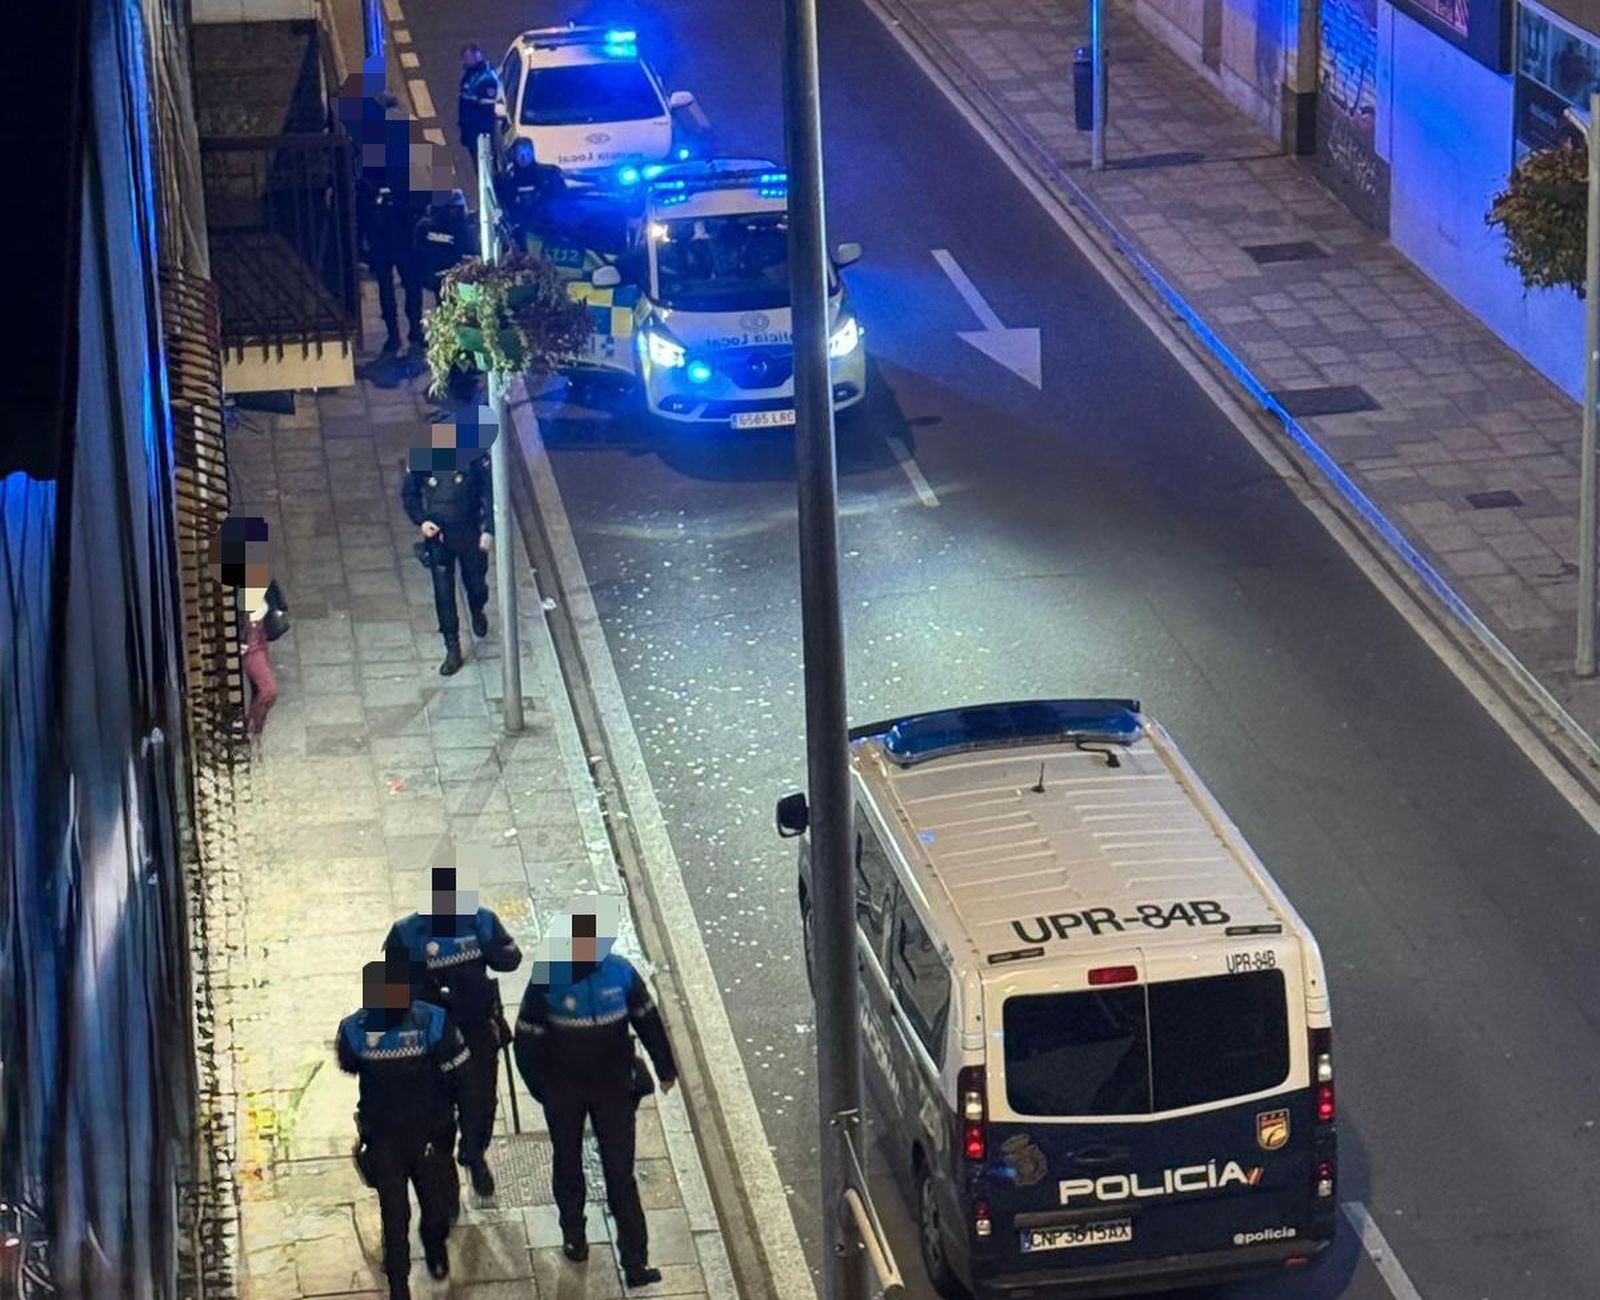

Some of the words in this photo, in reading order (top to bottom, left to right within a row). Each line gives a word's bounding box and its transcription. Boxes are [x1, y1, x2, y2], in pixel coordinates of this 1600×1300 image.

[1011, 900, 1231, 944] UPR-84B
[1225, 950, 1276, 973] UPR-84B
[1059, 1158, 1248, 1205] POLICÍA
